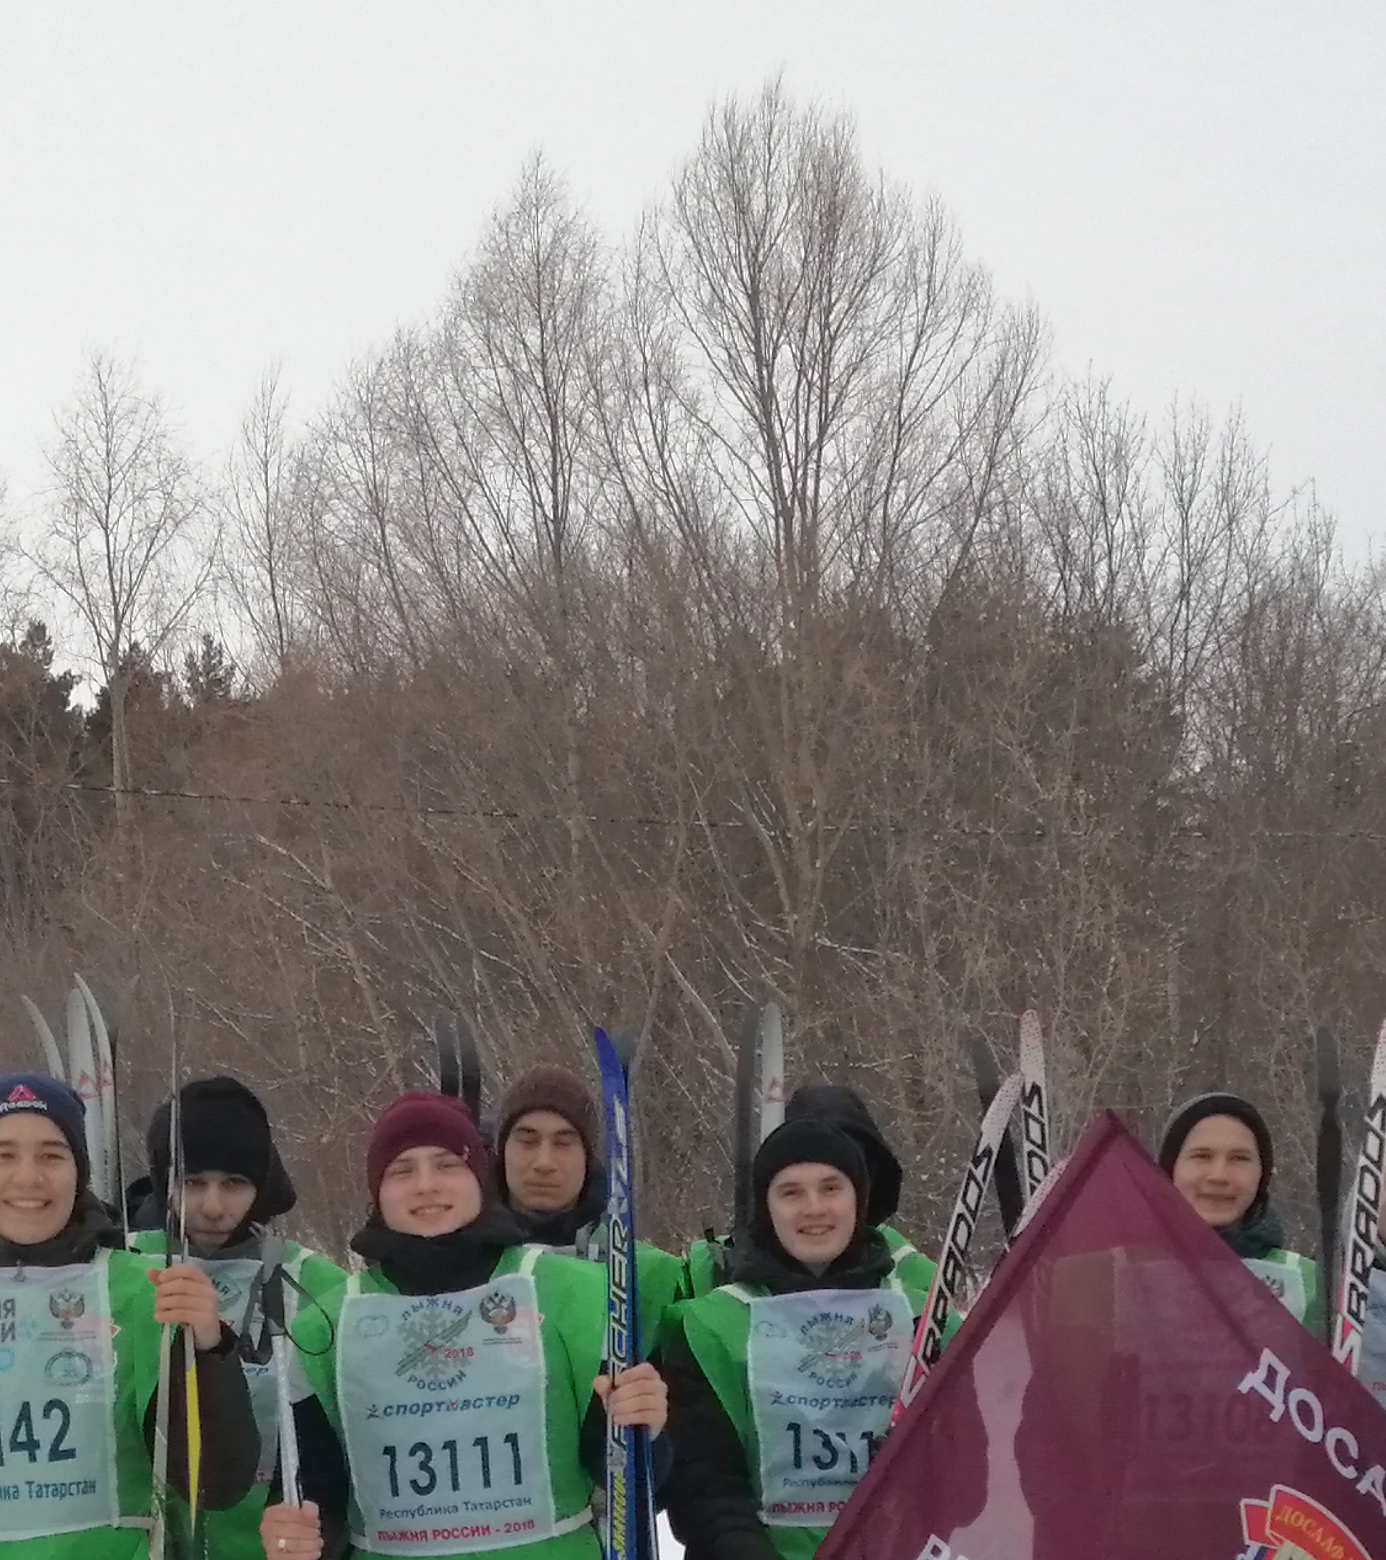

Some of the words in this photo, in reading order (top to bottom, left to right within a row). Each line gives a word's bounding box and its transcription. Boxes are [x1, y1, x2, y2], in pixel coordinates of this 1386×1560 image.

[401, 1297, 464, 1321] ЛЫЖНЯ
[407, 1371, 467, 1391] РОССИИ
[382, 1432, 523, 1498] 13111
[25, 1477, 98, 1501] Татарстан
[379, 1503, 459, 1521] Республика
[462, 1497, 533, 1514] Татарстан
[377, 1529, 428, 1542] ЛЫЖНЯ
[432, 1524, 491, 1540] РОССИИ
[504, 1519, 536, 1534] 2018
